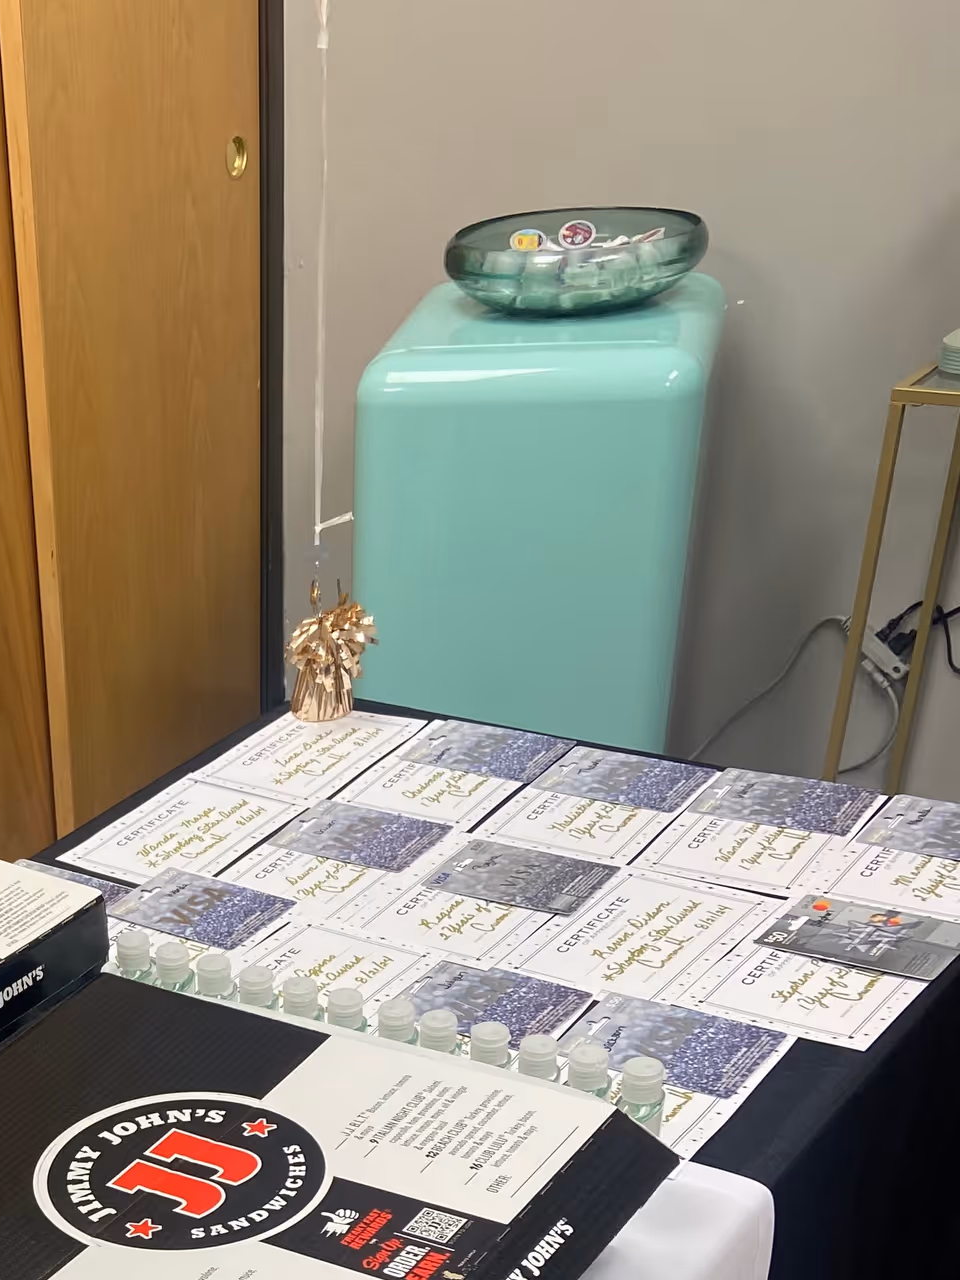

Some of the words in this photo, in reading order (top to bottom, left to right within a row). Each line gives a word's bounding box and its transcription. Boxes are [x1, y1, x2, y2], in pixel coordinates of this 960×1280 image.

[242, 724, 306, 766] CERTIFICATE
[219, 799, 250, 819] Award
[116, 800, 189, 847] CERTIFICATE
[136, 832, 178, 858] Wanda
[255, 850, 295, 880] CERTIF
[430, 872, 452, 886] VISA
[499, 864, 540, 887] VISA
[556, 896, 630, 954] CERTIFICATE
[666, 900, 702, 926] Award
[591, 931, 634, 960] Raven
[763, 931, 789, 944] $50
[741, 951, 782, 985] CERTIF
[393, 1103, 412, 1122] NIGHT
[369, 1136, 379, 1148] 9
[373, 1119, 398, 1140] ITALIAN
[432, 1135, 453, 1154] BEACH
[67, 1145, 117, 1223] JIMMY
[97, 1108, 227, 1146] JOHN'S
[105, 1127, 262, 1219] JJ
[469, 1160, 483, 1174] 16
[476, 1147, 495, 1164] CLUB
[190, 1144, 307, 1240] SANDWICHES
[486, 1176, 511, 1193] OTHER:
[341, 1221, 367, 1245] FREAKY
[363, 1208, 381, 1224] FAST
[345, 1211, 393, 1250] REWARDS
[362, 1249, 390, 1270] Sign
[520, 1217, 575, 1278] JOHN'S
[383, 1245, 431, 1279] ORDER.
